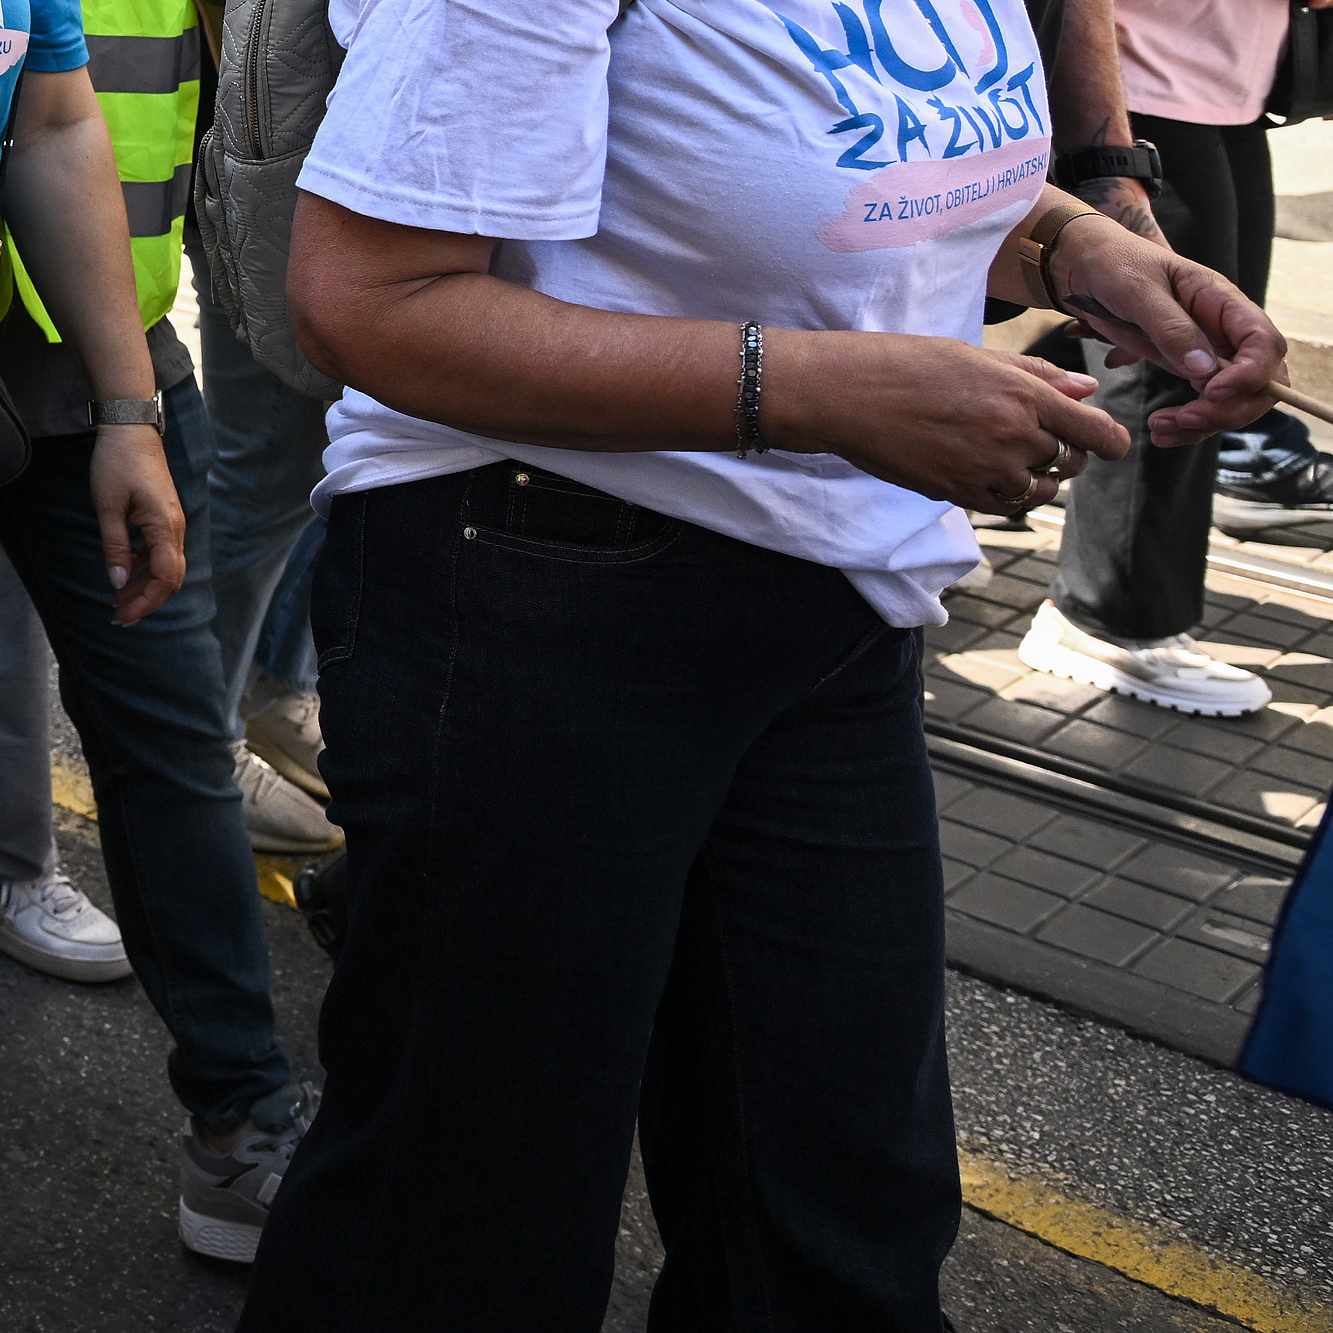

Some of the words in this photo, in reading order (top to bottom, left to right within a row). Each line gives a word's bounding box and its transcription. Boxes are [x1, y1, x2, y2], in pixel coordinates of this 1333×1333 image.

[826, 91, 932, 171] ZA
[925, 61, 1045, 159] ŽIVOT
[863, 202, 893, 222] ZA
[897, 195, 943, 220] ŽIVOT,
[945, 178, 990, 210] OBITELJ
